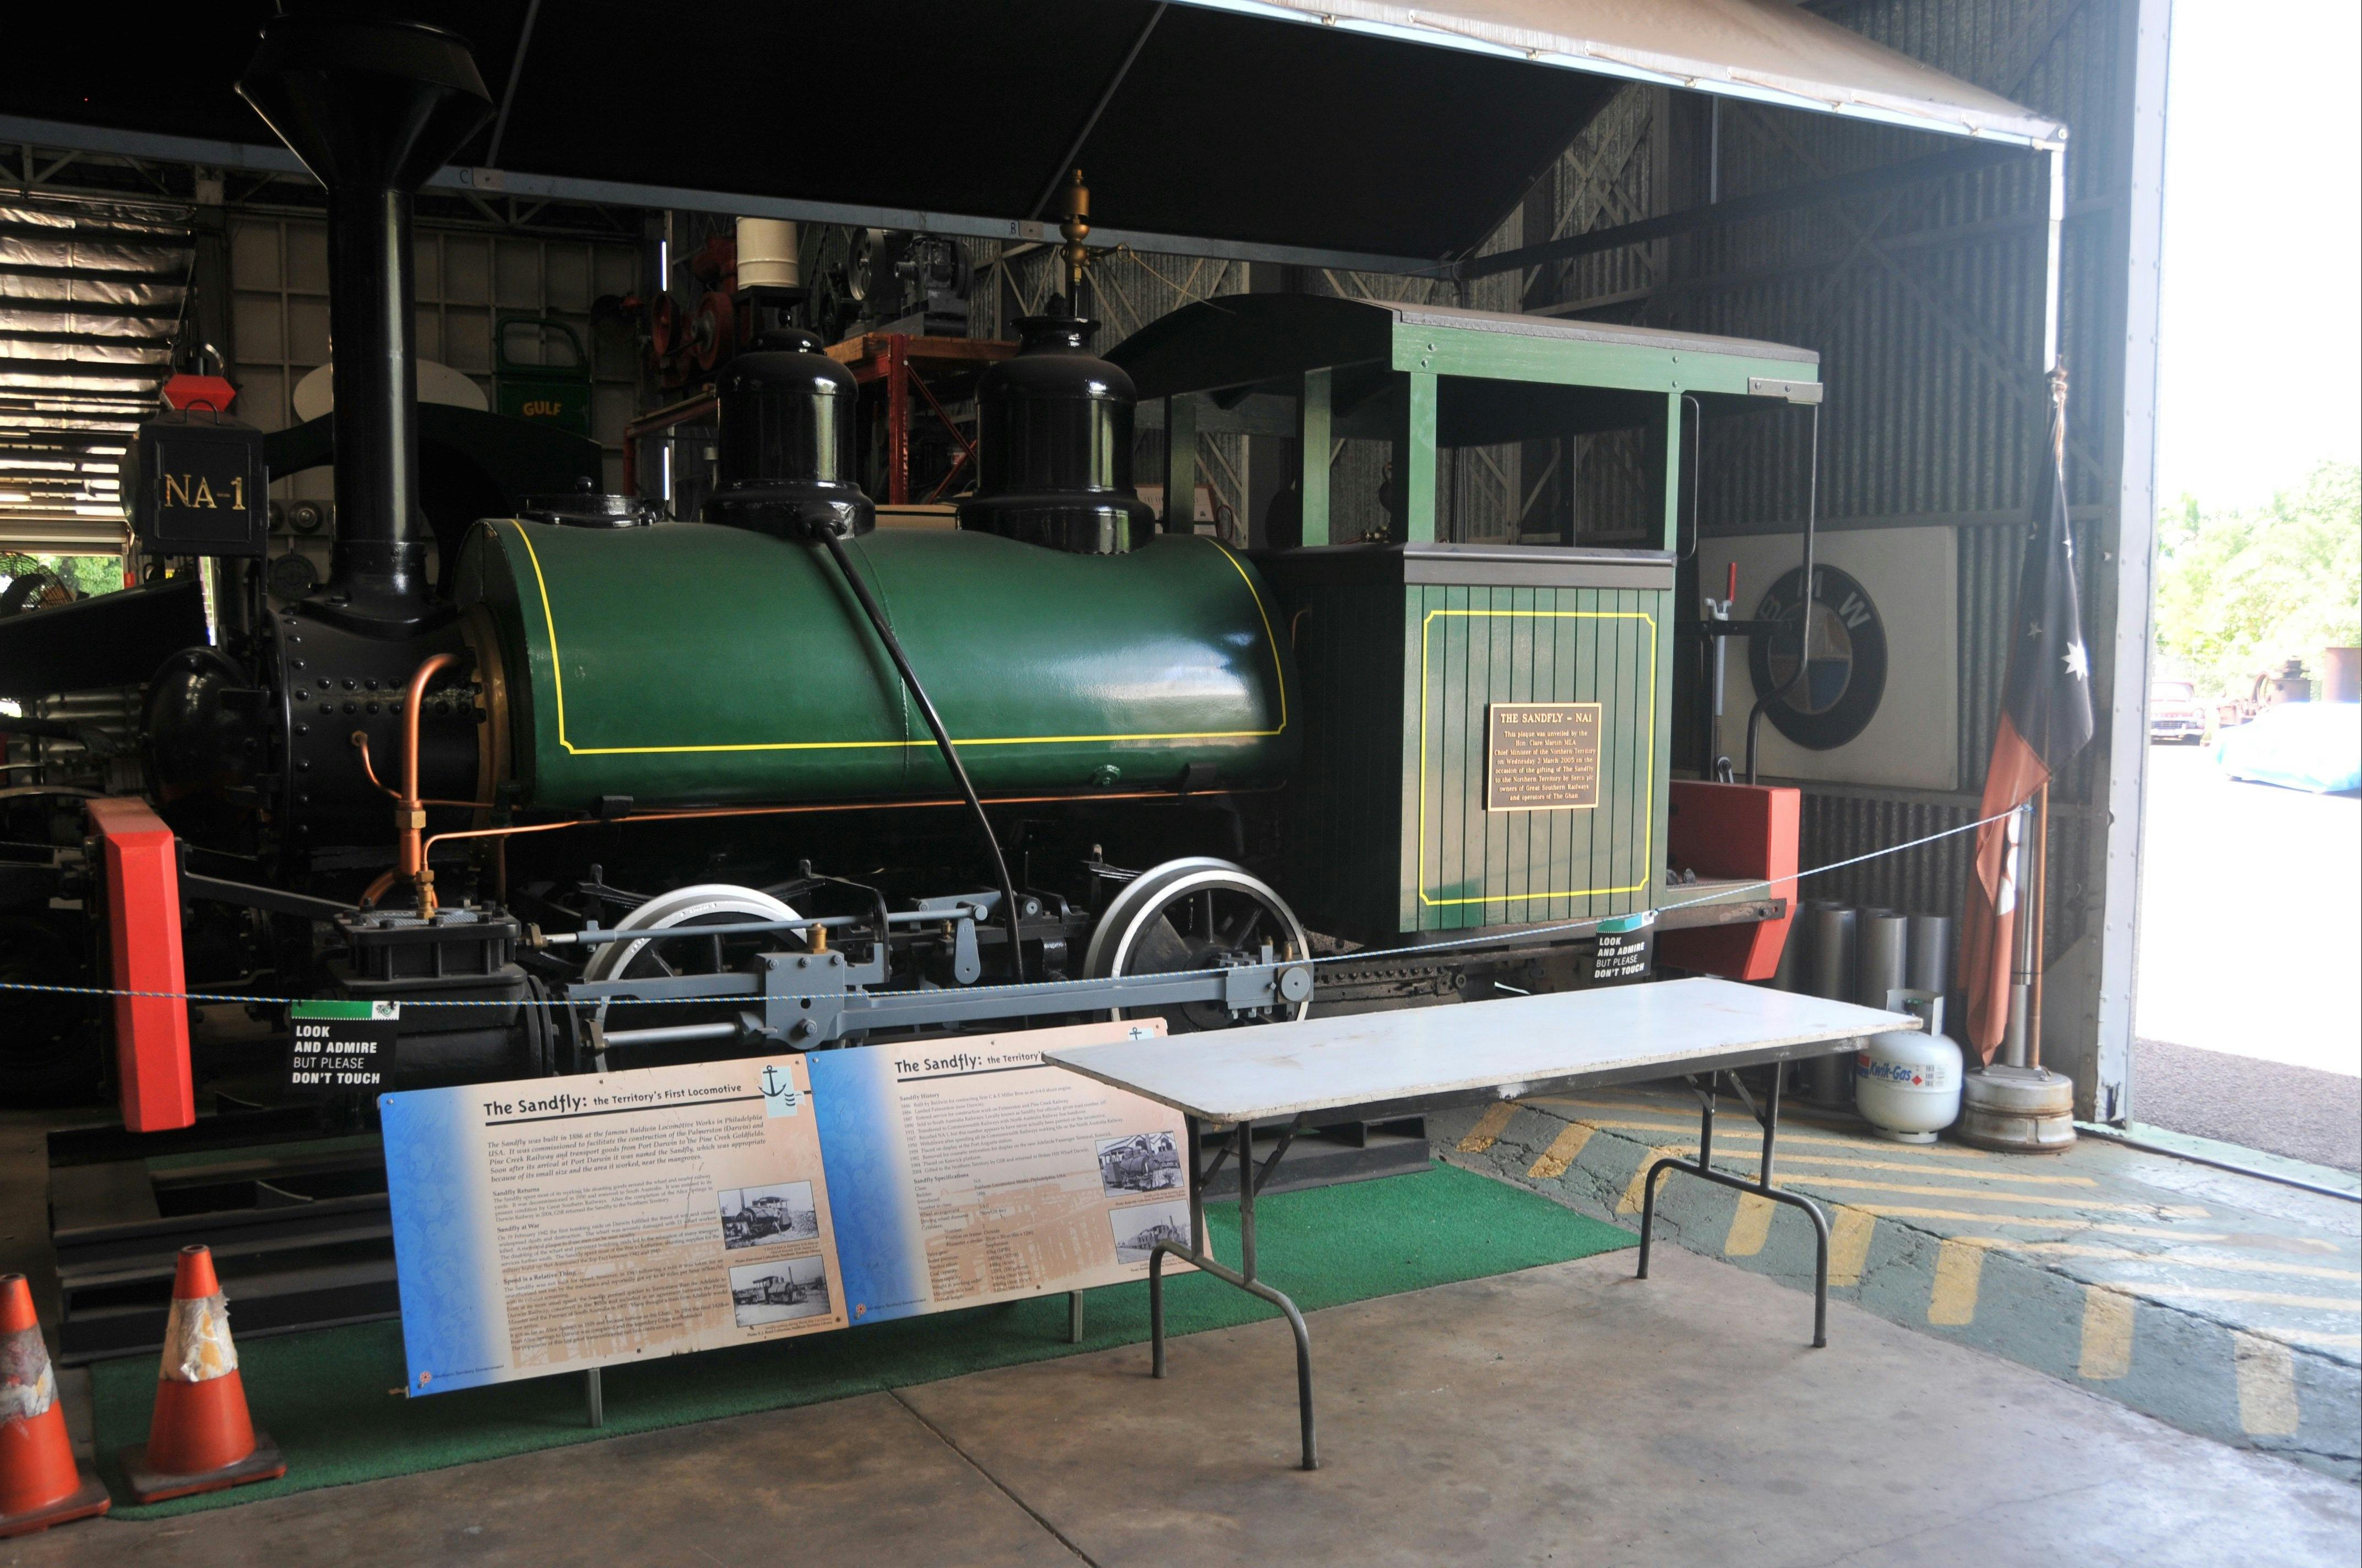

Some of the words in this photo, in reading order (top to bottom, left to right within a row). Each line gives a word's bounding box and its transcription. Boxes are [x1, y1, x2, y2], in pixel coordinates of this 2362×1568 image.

[523, 401, 561, 417] GULF
[164, 473, 246, 510] NA-1
[1500, 714, 1518, 723] THE
[1522, 713, 1562, 722] SANDFLY
[1574, 748, 1595, 756] Territory
[1536, 766, 1554, 775] gifting
[1539, 775, 1561, 783] Territory
[1567, 783, 1588, 792] Railways
[1522, 793, 1544, 802] operators
[1599, 937, 1621, 946] LOOK
[1598, 948, 1615, 956] AND
[1617, 941, 1644, 956] ADMIRE
[1597, 959, 1611, 968] BUT
[1613, 955, 1638, 966] PLEASE
[1594, 968, 1619, 978] DON'T
[1622, 962, 1644, 975] TOUCH
[296, 1026, 330, 1037] LOOK
[295, 1042, 321, 1053] AND
[327, 1042, 377, 1053] ADMIRE
[294, 1057, 317, 1068] BUT
[321, 1058, 365, 1069] PLEASE
[895, 1060, 919, 1073] The
[925, 1053, 982, 1071] Sandfly:
[987, 1056, 1000, 1064] the
[1003, 1051, 1041, 1063] Territory'
[1870, 1060, 1912, 1081] Kwik-Gas
[292, 1072, 332, 1084] DON'T
[337, 1073, 380, 1084] TOUCH
[484, 1102, 512, 1115] The
[519, 1094, 587, 1114] Sandfly:
[594, 1096, 609, 1106] the
[612, 1091, 661, 1104] Territory's
[665, 1089, 685, 1098] First
[688, 1084, 741, 1097] Locomotive
[501, 1139, 525, 1148] Sandfly
[630, 1125, 655, 1133] Baldwin
[659, 1121, 693, 1130] Locomotive
[725, 1114, 762, 1125] Philadelphia
[531, 1142, 576, 1152] commissioned
[587, 1138, 615, 1146] facilitate
[628, 1132, 666, 1142] construction
[688, 1126, 721, 1135] Palmerston
[724, 1123, 751, 1133] (Darwin)
[526, 1153, 553, 1163] Railway
[570, 1148, 599, 1158] transport
[601, 1146, 619, 1155] goods
[654, 1139, 677, 1147] Darwin
[732, 1130, 764, 1139] Goldfields.
[537, 1161, 558, 1169] arrival
[587, 1155, 610, 1163] Darwin
[670, 1146, 694, 1156] Sandfly,
[731, 1138, 765, 1149] appropriate
[935, 1173, 969, 1182] Specifications
[503, 1276, 522, 1285] Speed
